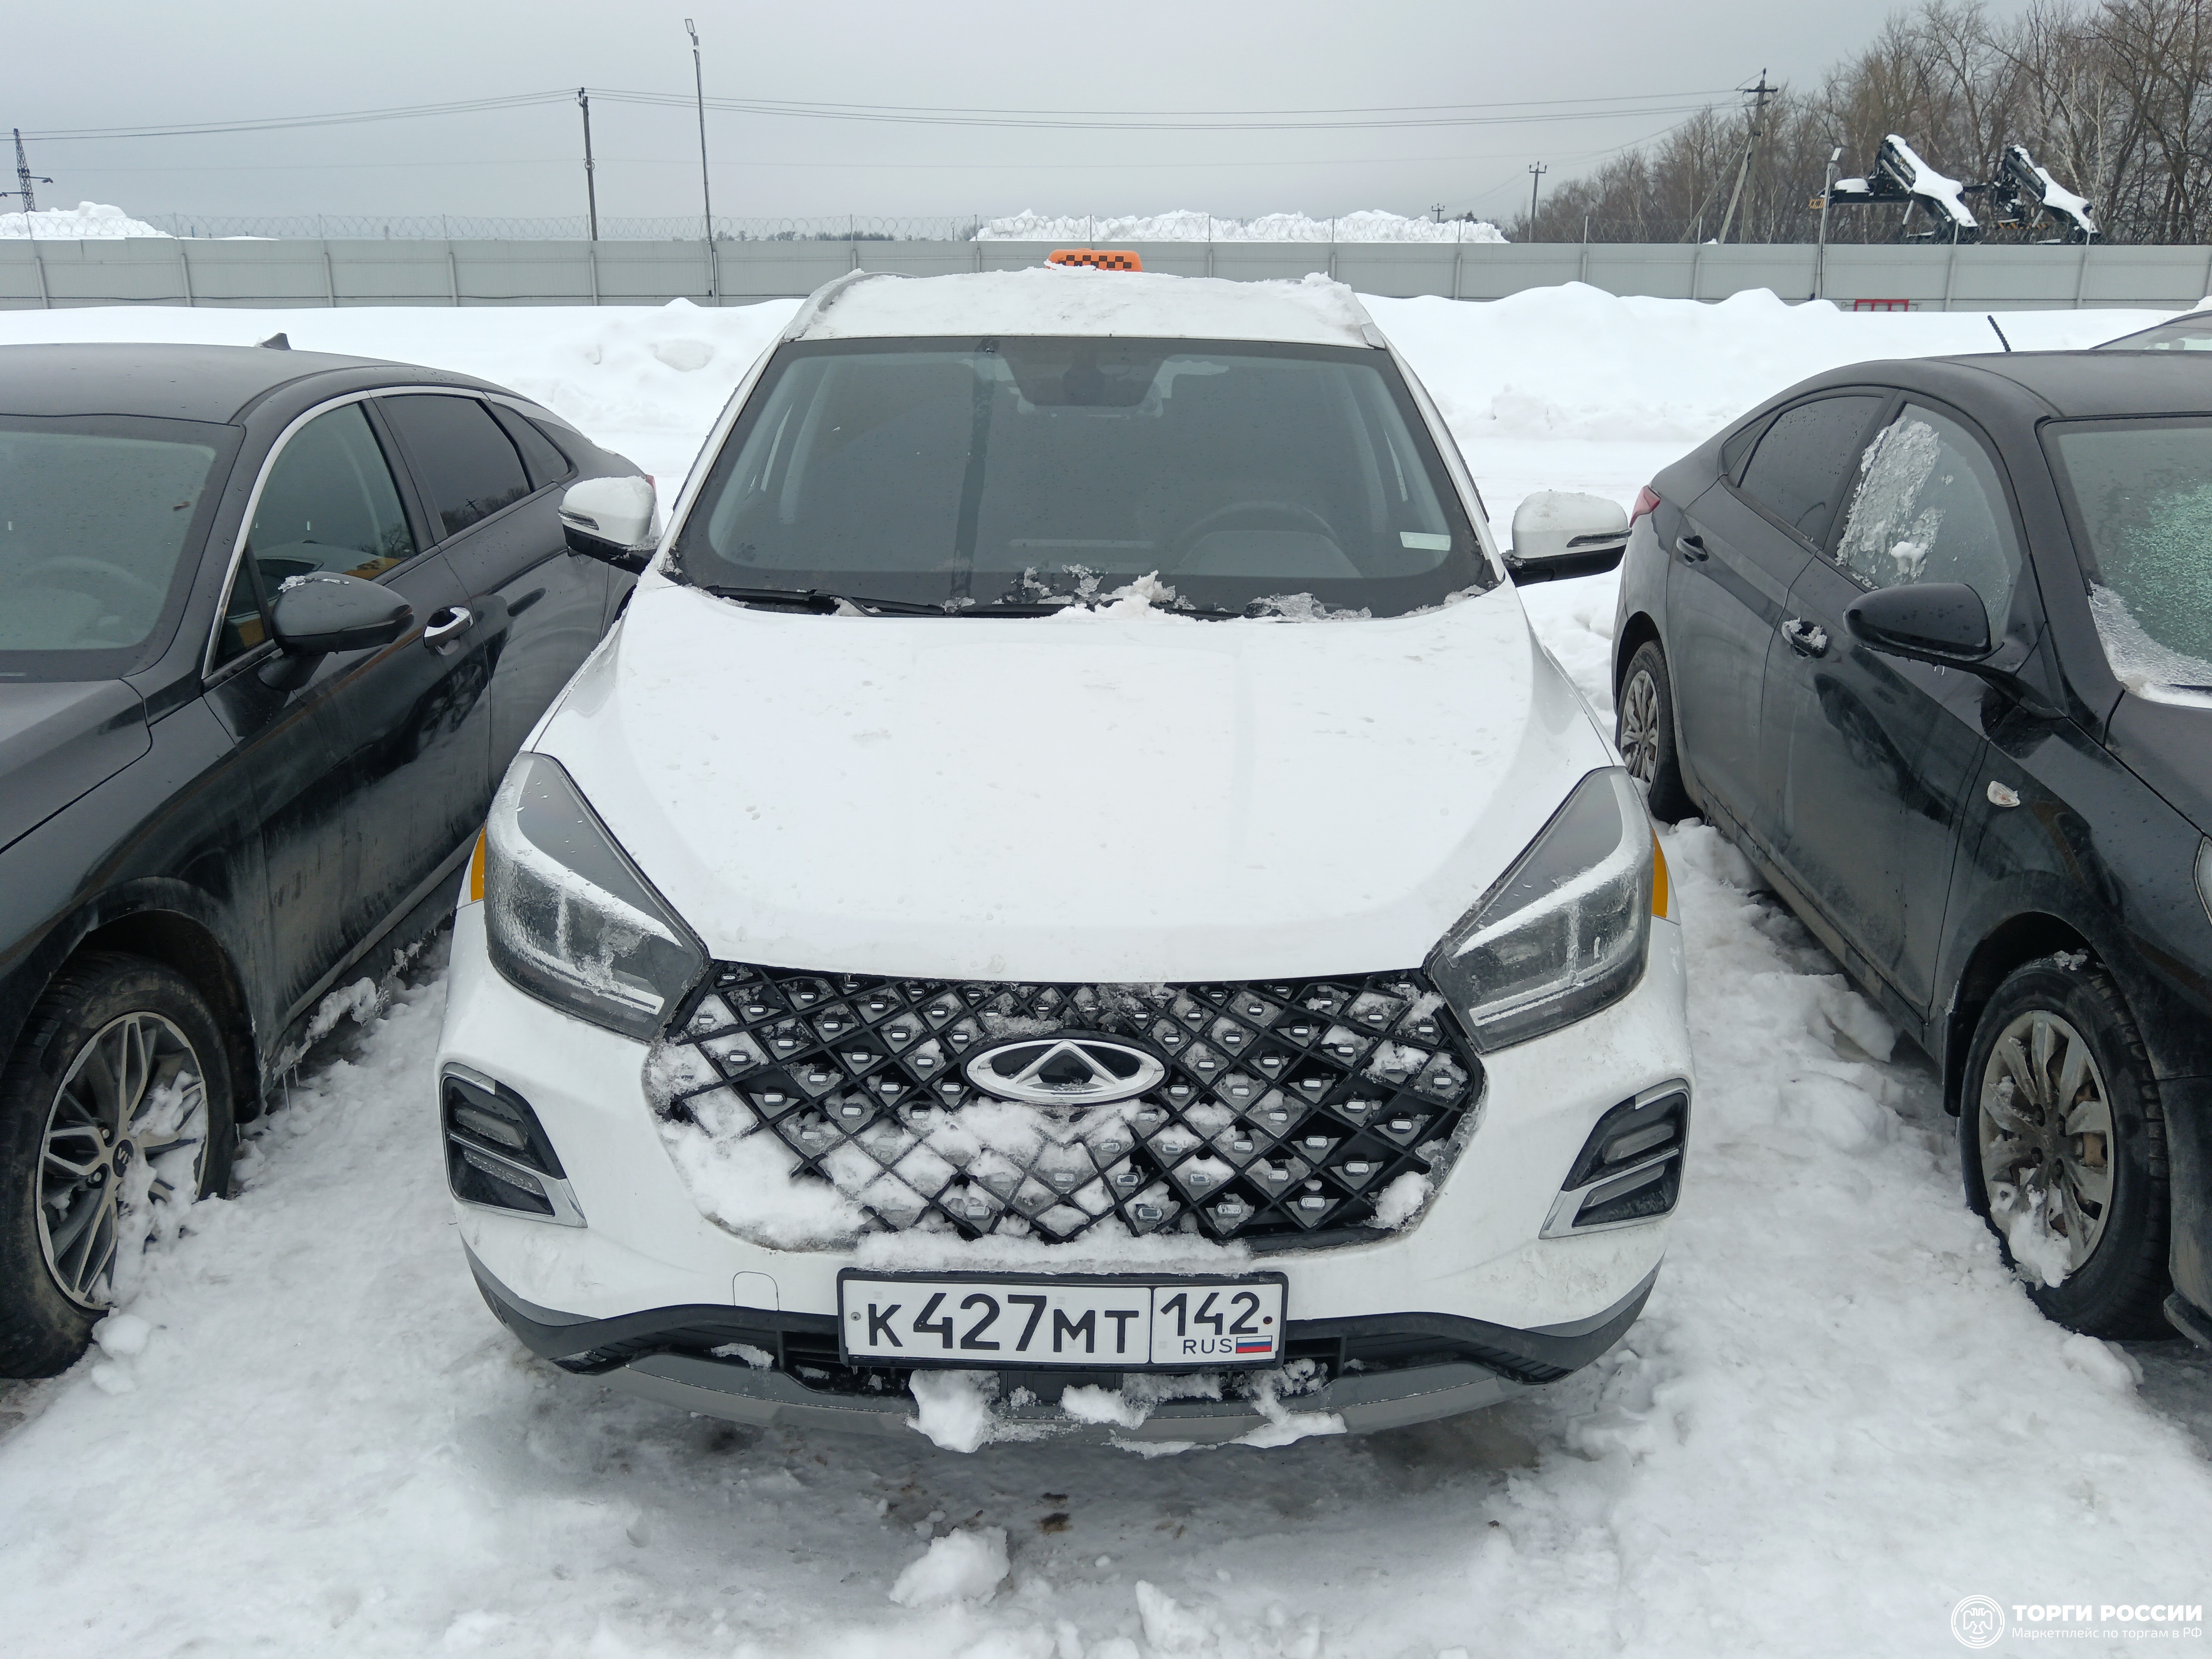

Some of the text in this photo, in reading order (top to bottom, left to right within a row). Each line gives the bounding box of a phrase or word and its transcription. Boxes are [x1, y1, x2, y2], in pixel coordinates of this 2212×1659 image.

[868, 1292, 1260, 1354] К427МТ 142
[1183, 1338, 1232, 1354] RUS
